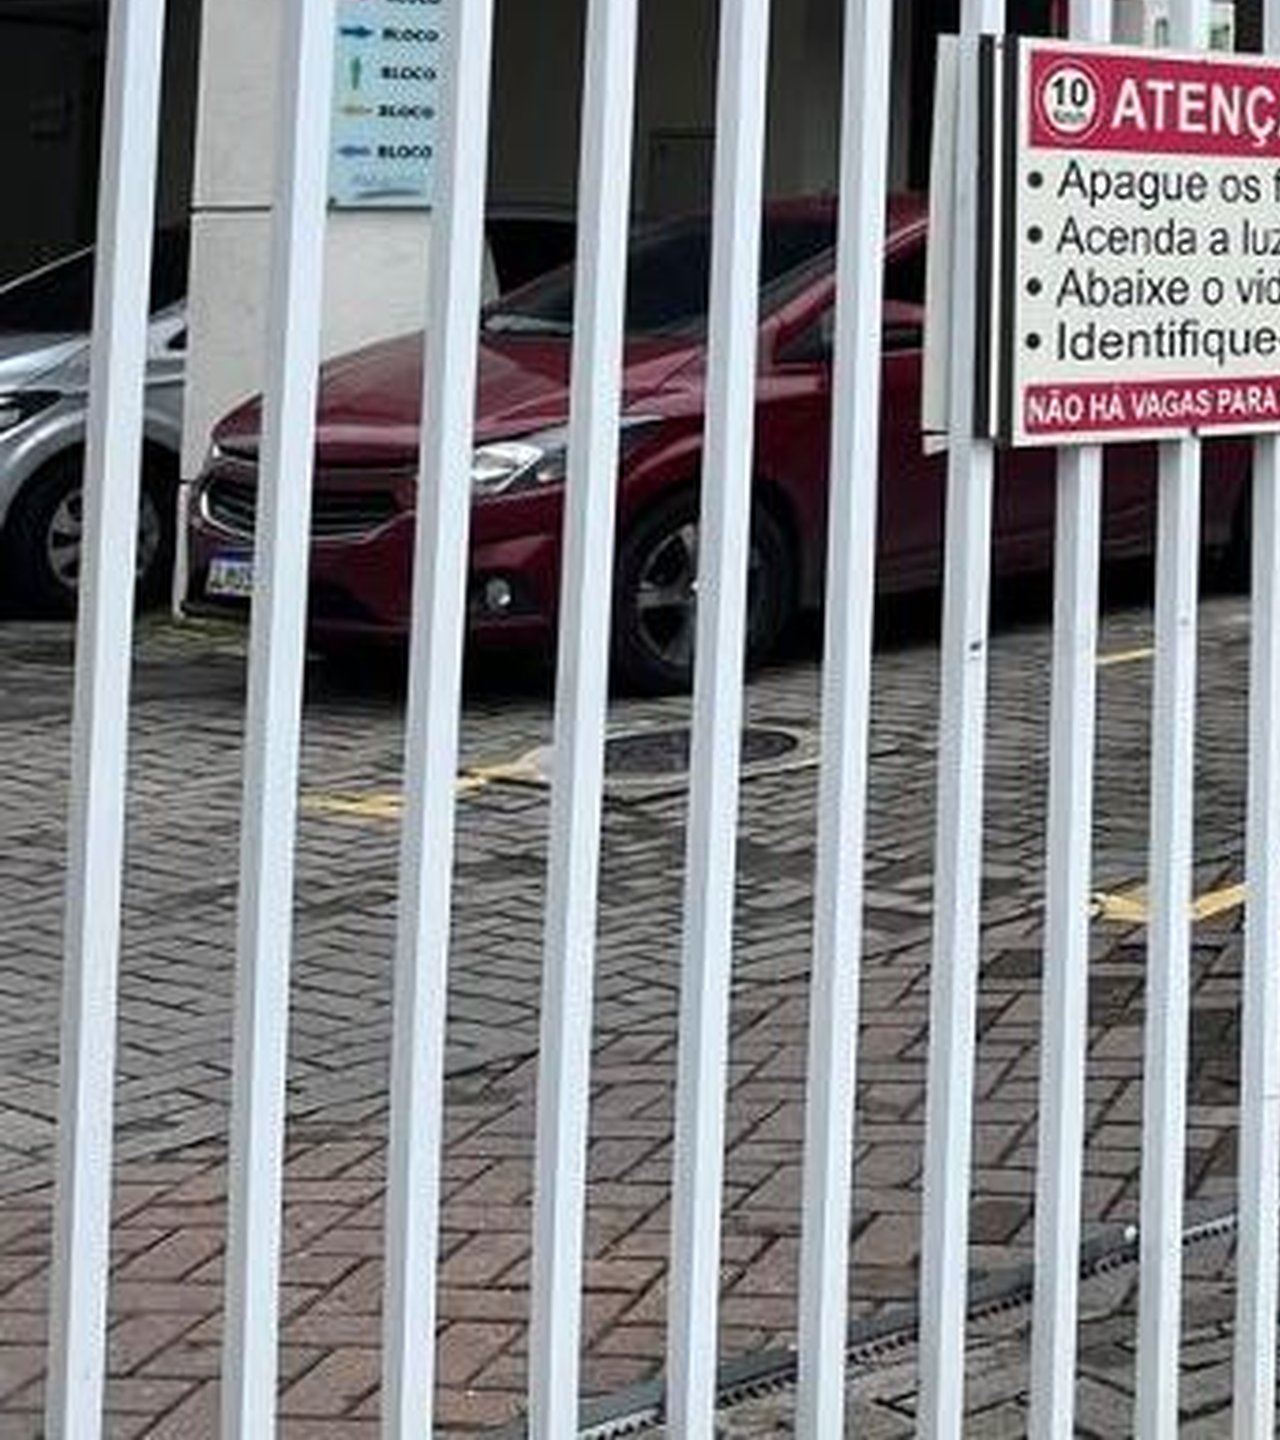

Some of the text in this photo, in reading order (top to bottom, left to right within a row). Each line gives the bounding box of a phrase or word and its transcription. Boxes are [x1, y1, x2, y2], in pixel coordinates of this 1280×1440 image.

[1052, 77, 1088, 107] 10
[1057, 161, 1207, 209] Apague
[1220, 173, 1261, 203] os
[1056, 218, 1197, 256] Acenda
[1209, 231, 1230, 257] a
[1056, 269, 1190, 307] Abaixe
[1203, 281, 1225, 306] o
[1029, 390, 1081, 424] NÃO
[1089, 393, 1124, 421] HÁ
[1131, 390, 1210, 419] VAGAS
[1216, 389, 1277, 415] PARA
